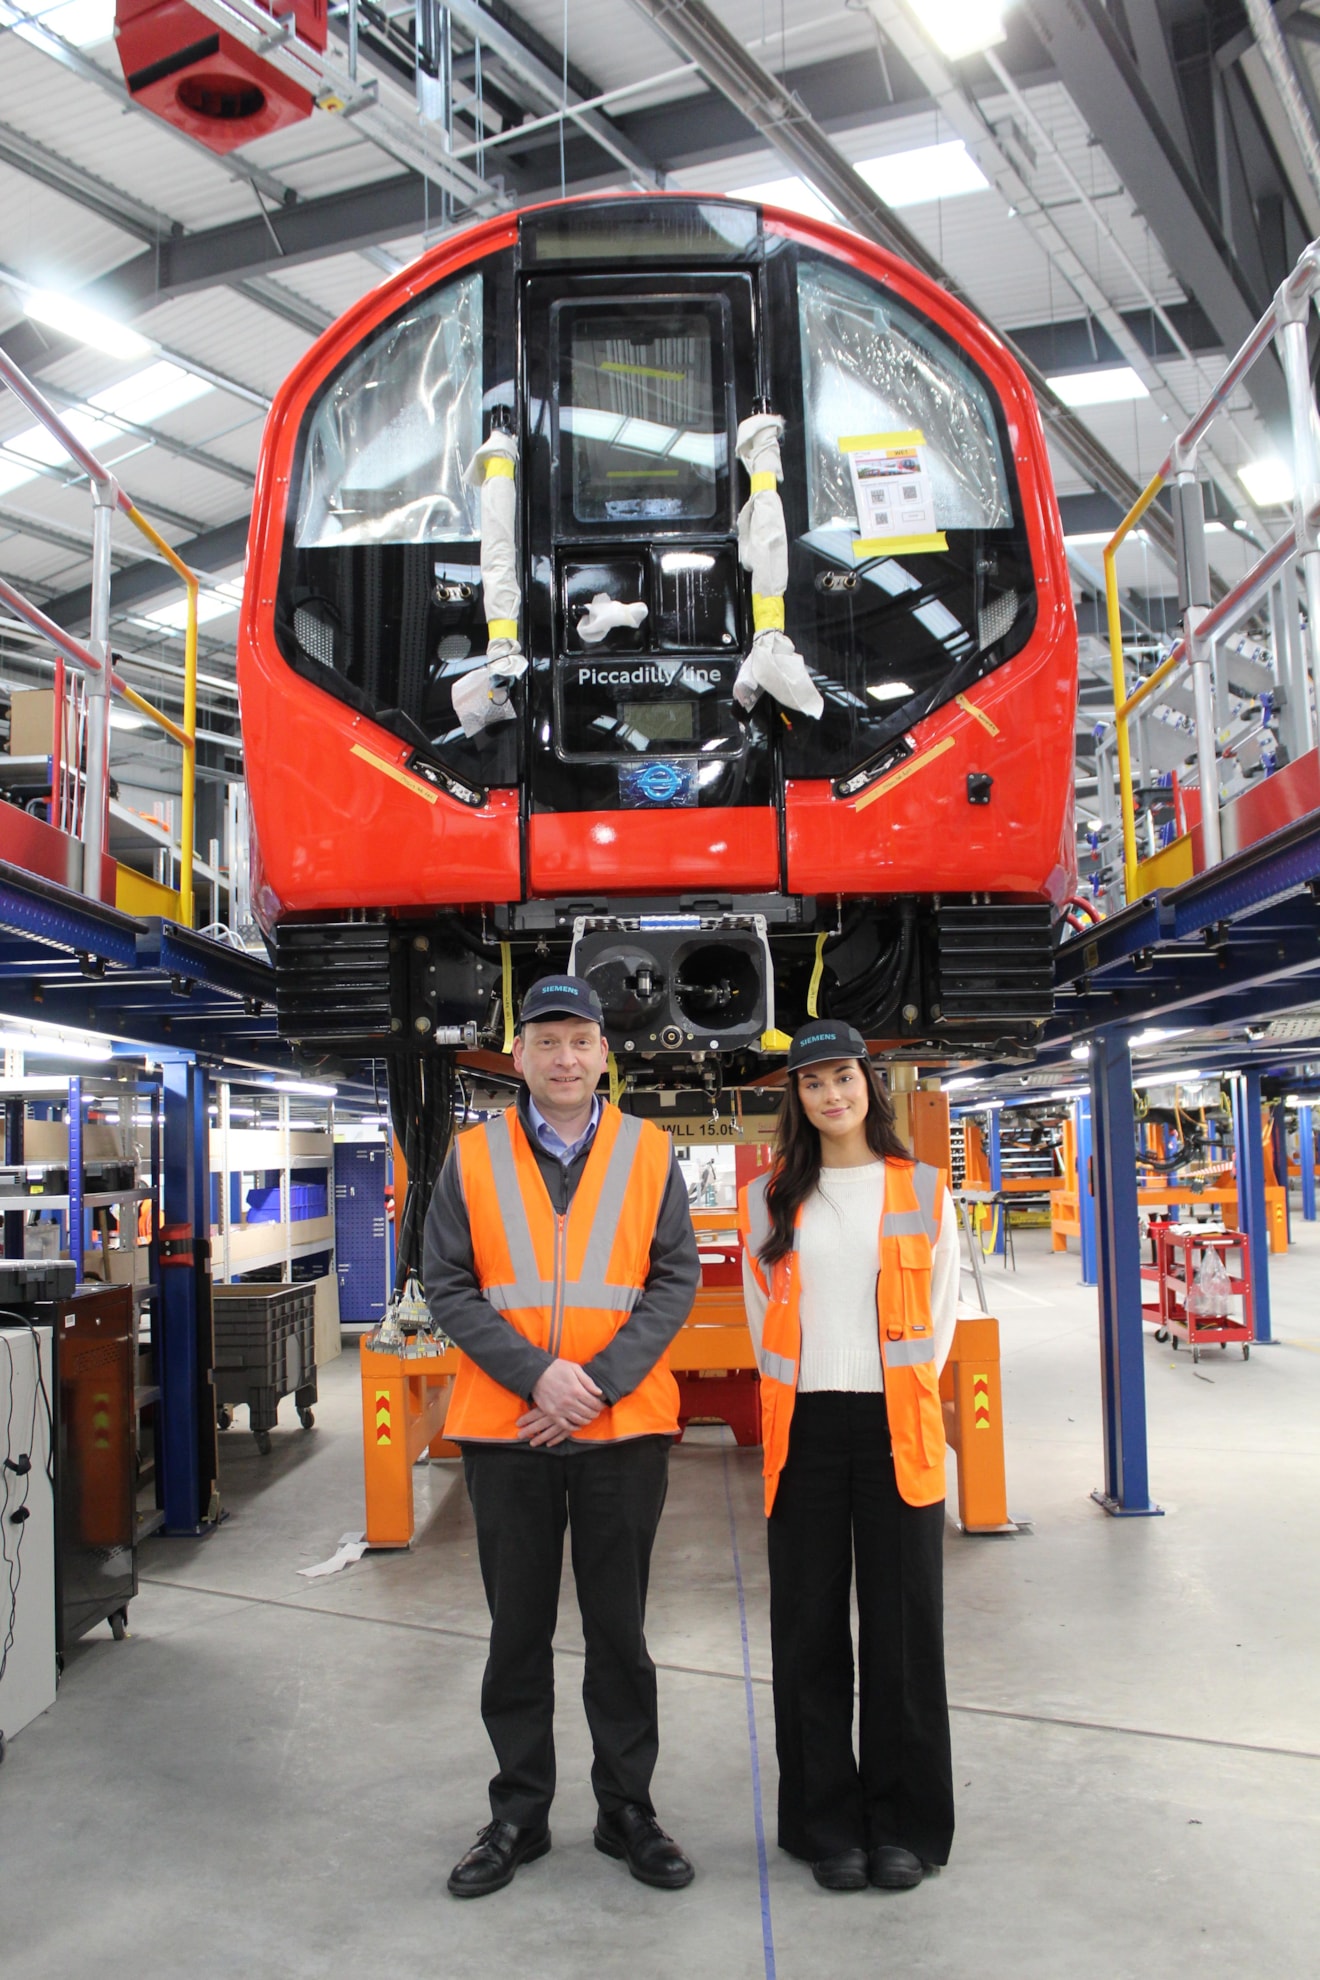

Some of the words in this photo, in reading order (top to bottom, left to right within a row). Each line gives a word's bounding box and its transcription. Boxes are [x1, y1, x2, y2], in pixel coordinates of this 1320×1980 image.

[579, 667, 675, 686] Piccadilly
[682, 666, 722, 682] line
[542, 985, 579, 996] SIEMENS
[800, 1033, 837, 1048] SIEMENS
[699, 1124, 734, 1136] 15.0t
